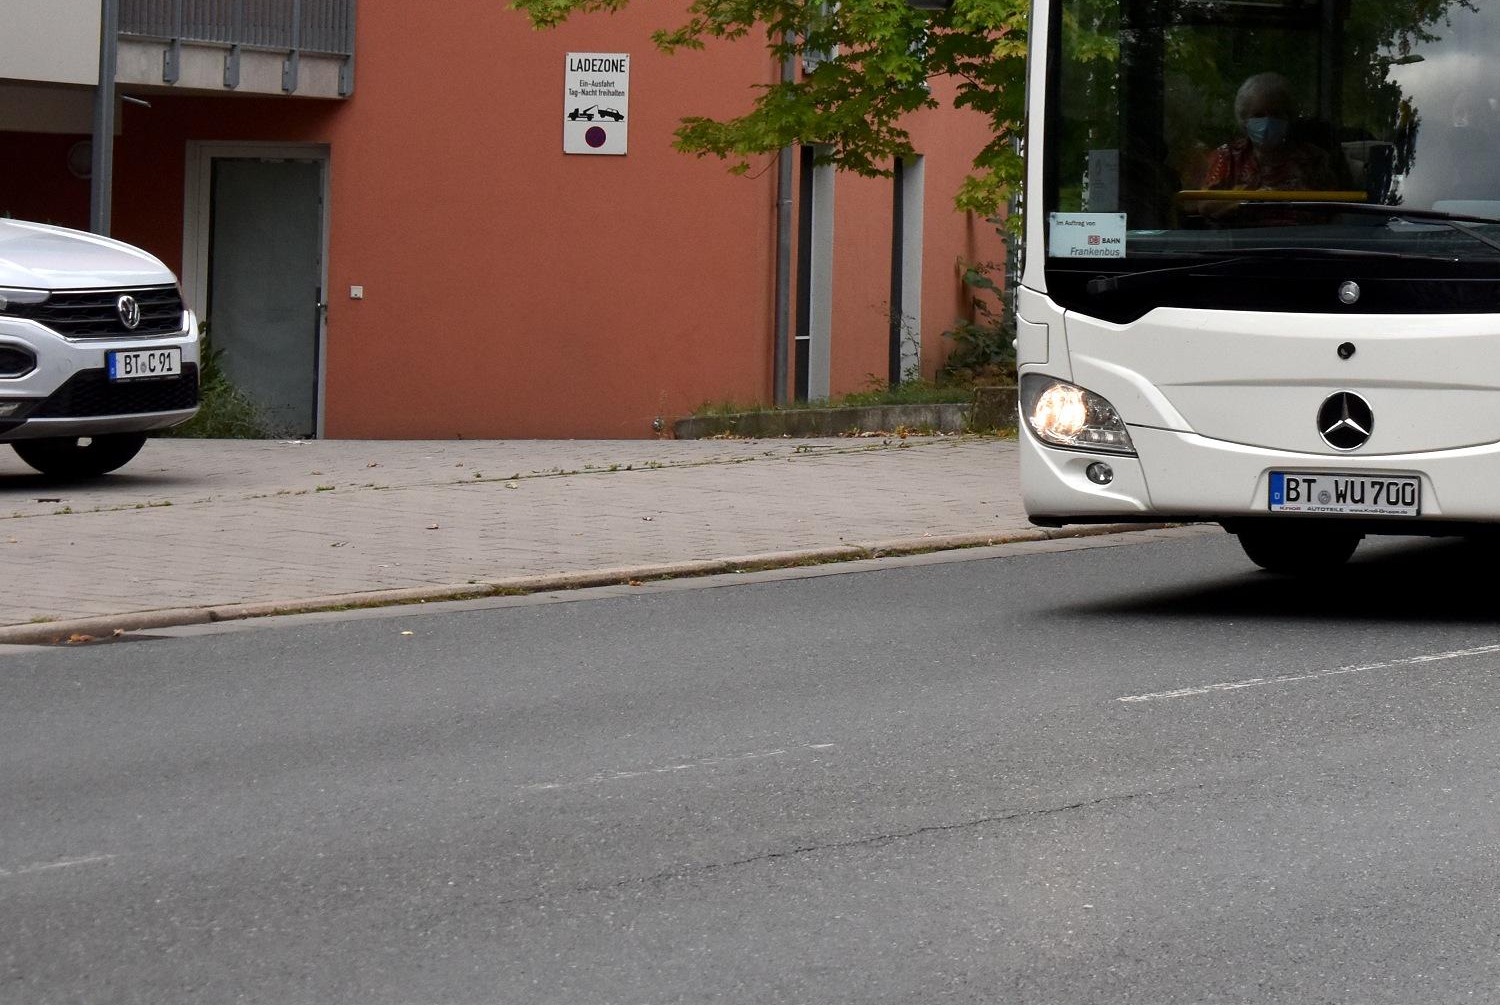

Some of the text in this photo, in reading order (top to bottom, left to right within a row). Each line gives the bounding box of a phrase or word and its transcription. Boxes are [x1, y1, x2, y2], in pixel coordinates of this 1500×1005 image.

[570, 58, 626, 73] LADEZONE
[579, 79, 615, 88] Ein-Ausfahrt
[568, 88, 625, 97] Tag-Nacht freihalten
[1070, 247, 1120, 256] Frankenbus
[124, 351, 173, 374] BT C 91
[1286, 478, 1316, 502] BT
[1334, 479, 1365, 504] WU
[1371, 481, 1415, 506] 700
